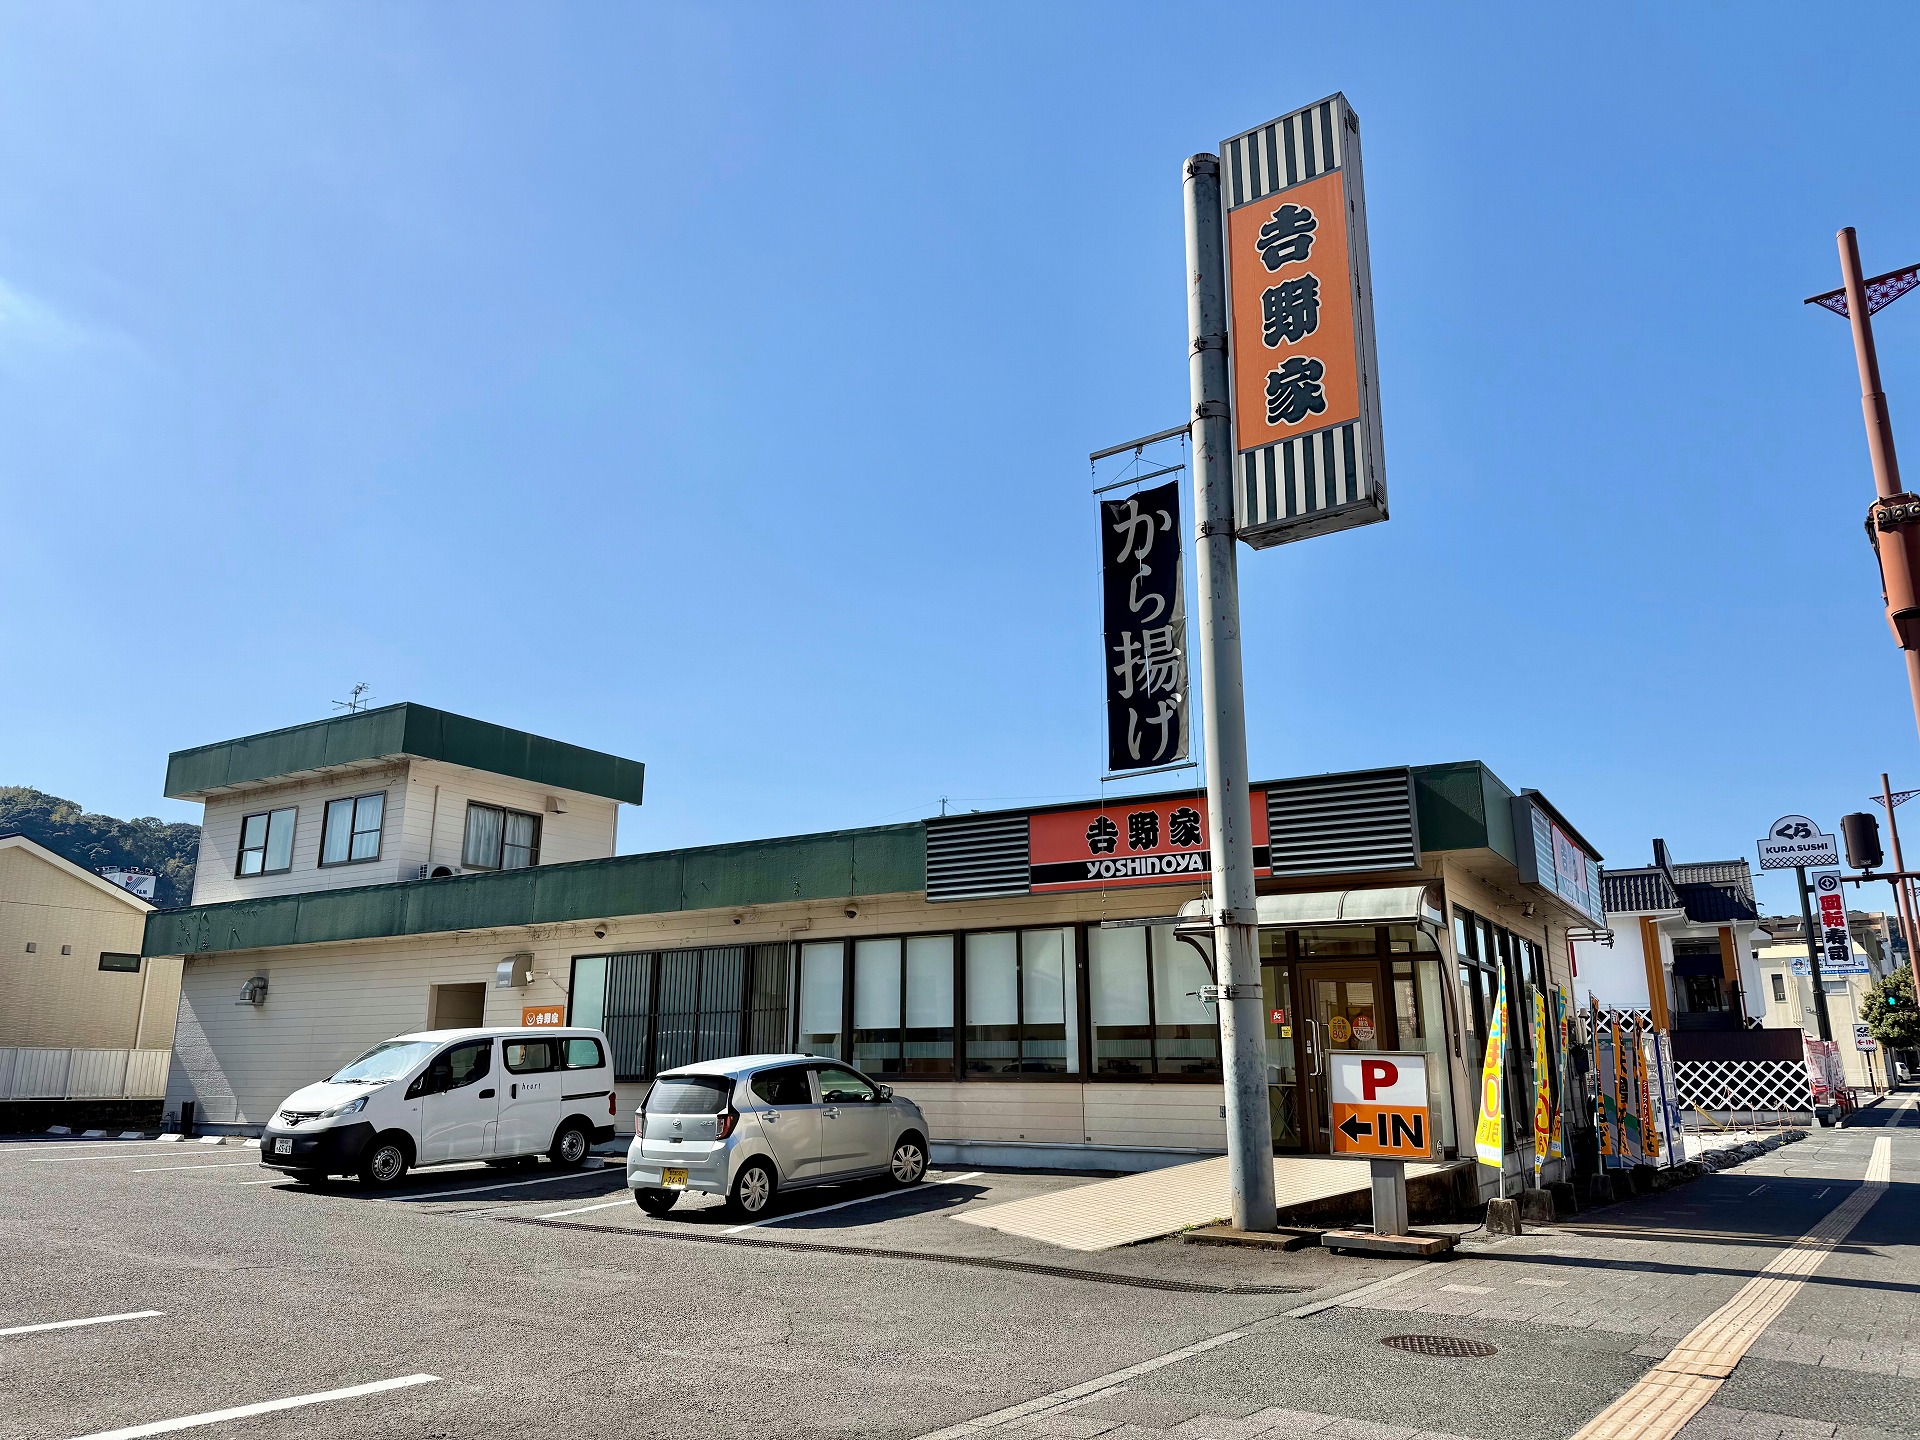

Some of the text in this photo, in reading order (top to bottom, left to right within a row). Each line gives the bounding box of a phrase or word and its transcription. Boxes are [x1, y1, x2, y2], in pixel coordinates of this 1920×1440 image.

[1256, 203, 1328, 427] 吉野家
[1113, 499, 1182, 762] から揚げ
[1085, 806, 1203, 855] 吉野家
[1765, 842, 1829, 854] KURA SUSHI
[1775, 822, 1812, 840] くら
[1086, 853, 1204, 879] YOSHINOYA
[1818, 893, 1851, 962] 回転寿司
[1361, 1059, 1399, 1100] P
[1377, 1112, 1424, 1149] IN
